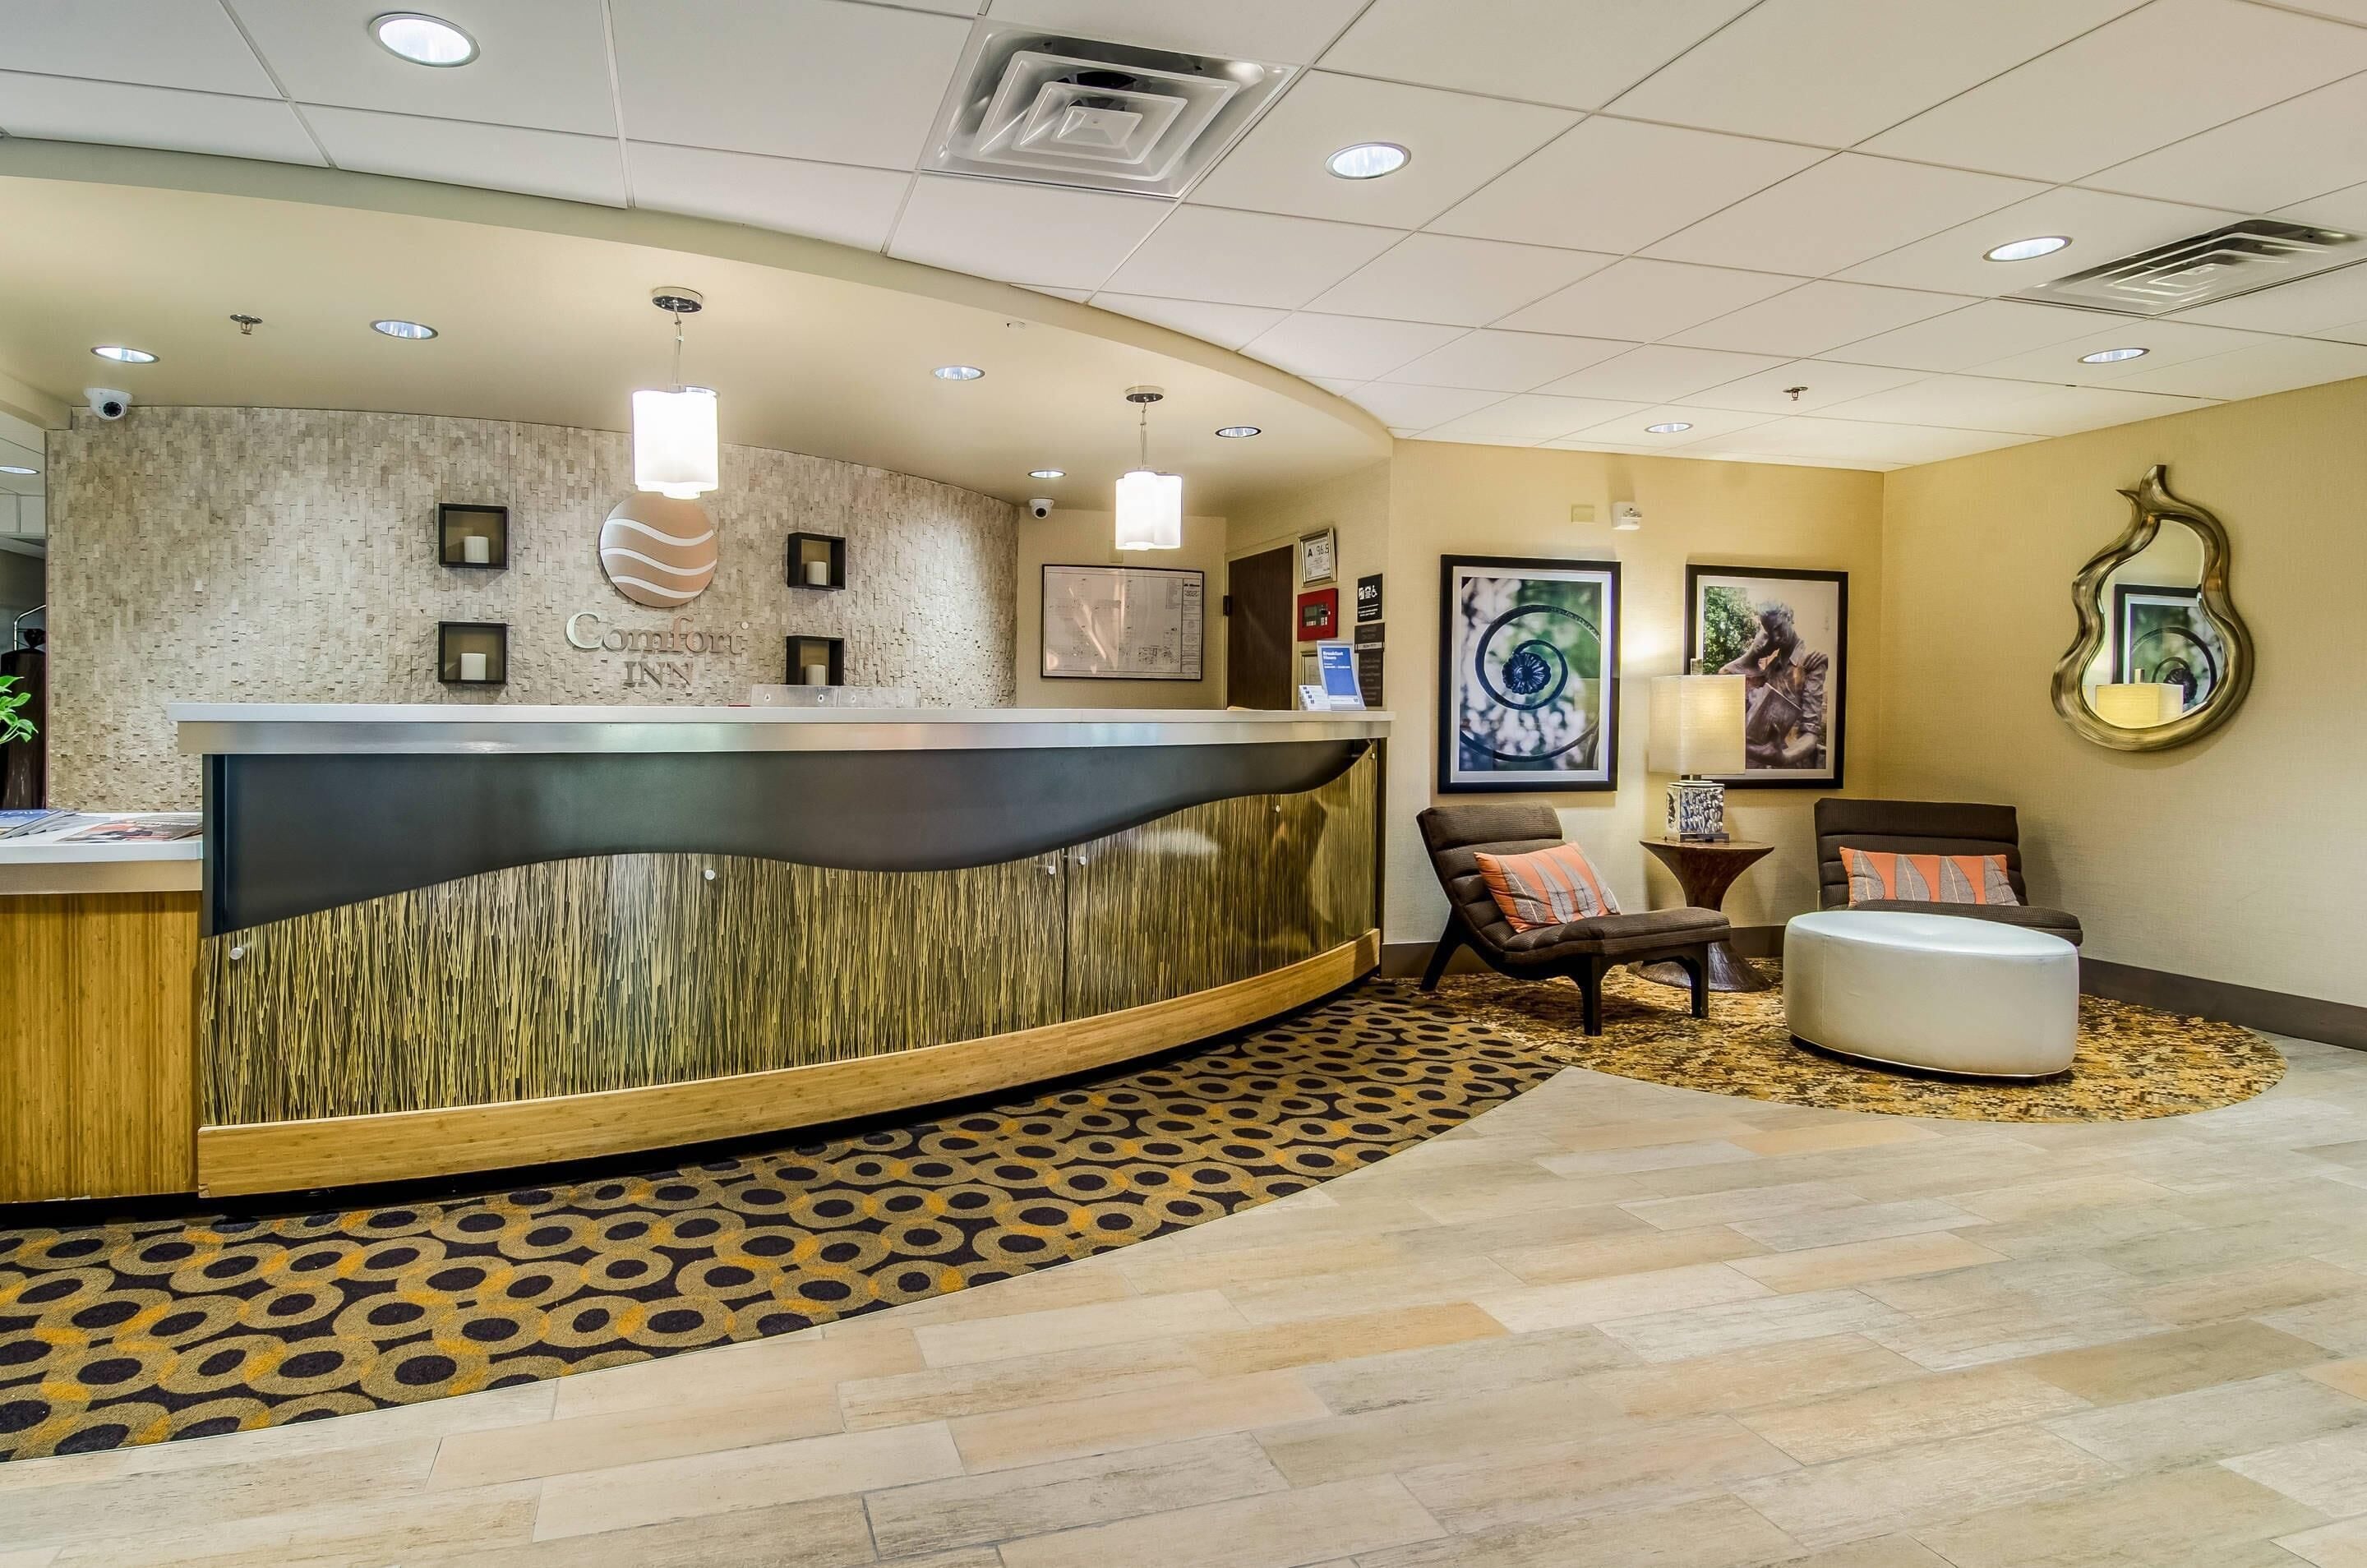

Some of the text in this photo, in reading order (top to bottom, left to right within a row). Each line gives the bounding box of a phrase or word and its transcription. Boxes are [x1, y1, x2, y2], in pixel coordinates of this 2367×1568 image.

[1308, 548, 1313, 557] A
[565, 611, 743, 654] Comfort
[623, 661, 693, 688] INN
